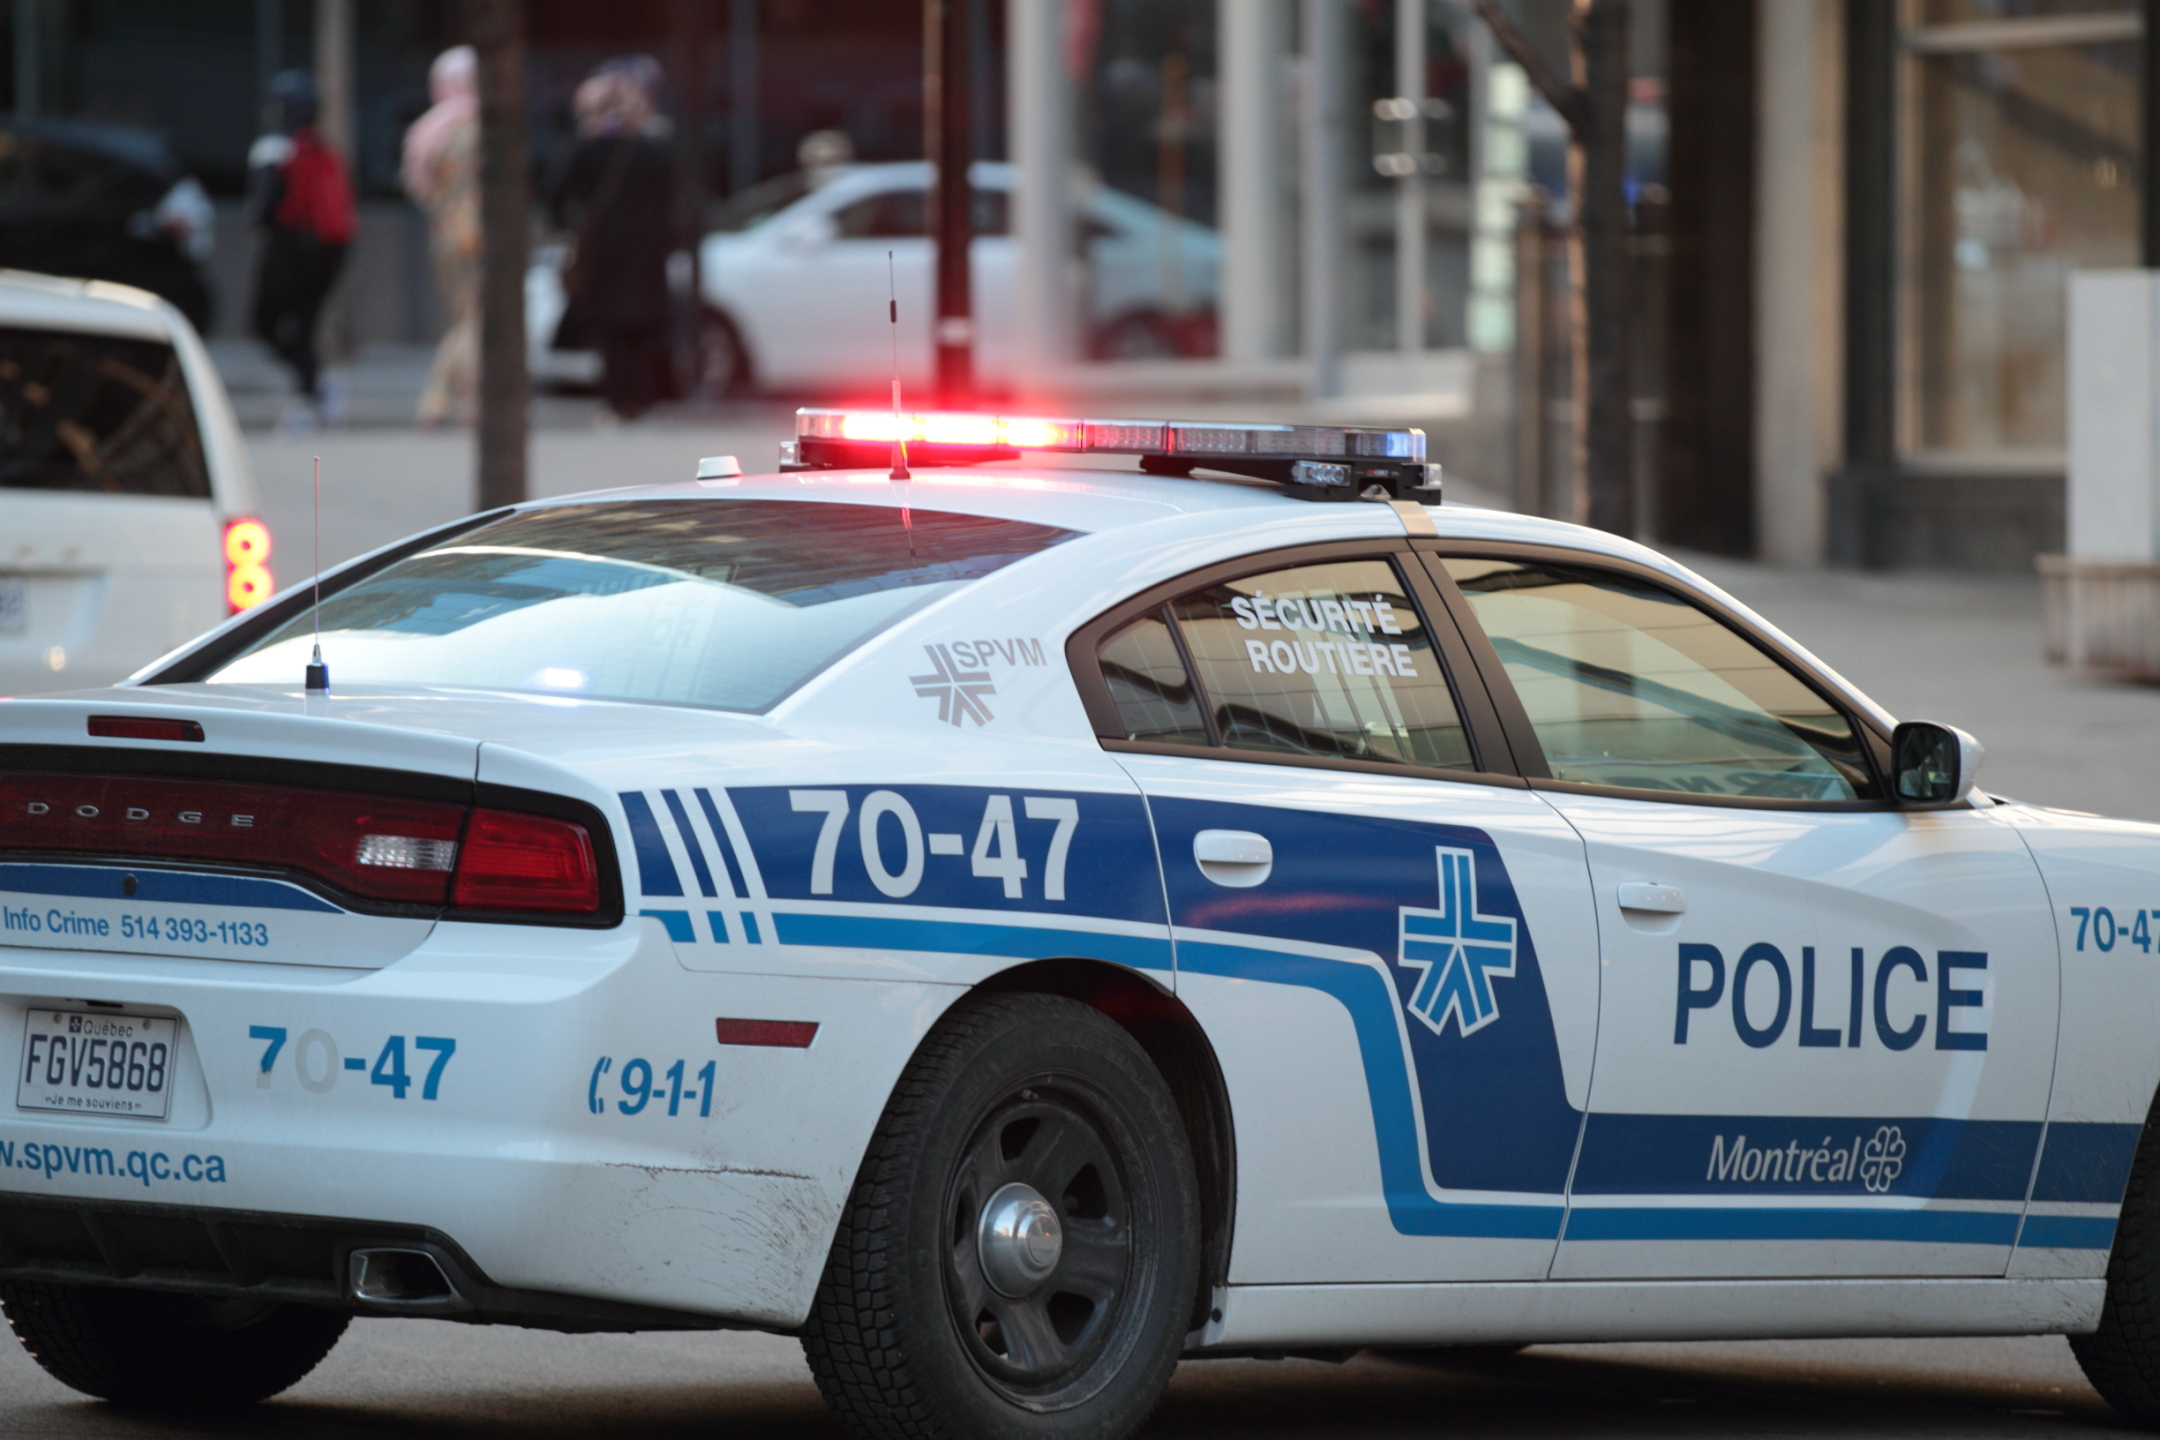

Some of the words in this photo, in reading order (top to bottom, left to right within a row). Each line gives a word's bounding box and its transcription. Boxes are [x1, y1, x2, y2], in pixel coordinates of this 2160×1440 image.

[1231, 590, 1402, 634] SÉCURITÉ
[951, 638, 1047, 668] SPVM
[1244, 634, 1418, 677] ROUTIÈRE
[27, 802, 254, 827] DODGE
[788, 789, 1080, 901] 70-47
[3, 906, 41, 932] Info
[47, 909, 110, 937] Crime
[121, 915, 160, 940] 514
[165, 917, 269, 947] 393-1133
[1674, 942, 1988, 1051] POLICE
[83, 1020, 133, 1037] Québec
[26, 1033, 168, 1092] FGV5868
[51, 1093, 64, 1105] Je
[67, 1096, 83, 1107] me
[86, 1096, 133, 1111] souviens
[617, 1057, 717, 1118] 9-1-1
[1706, 1136, 1862, 1182] Montréal
